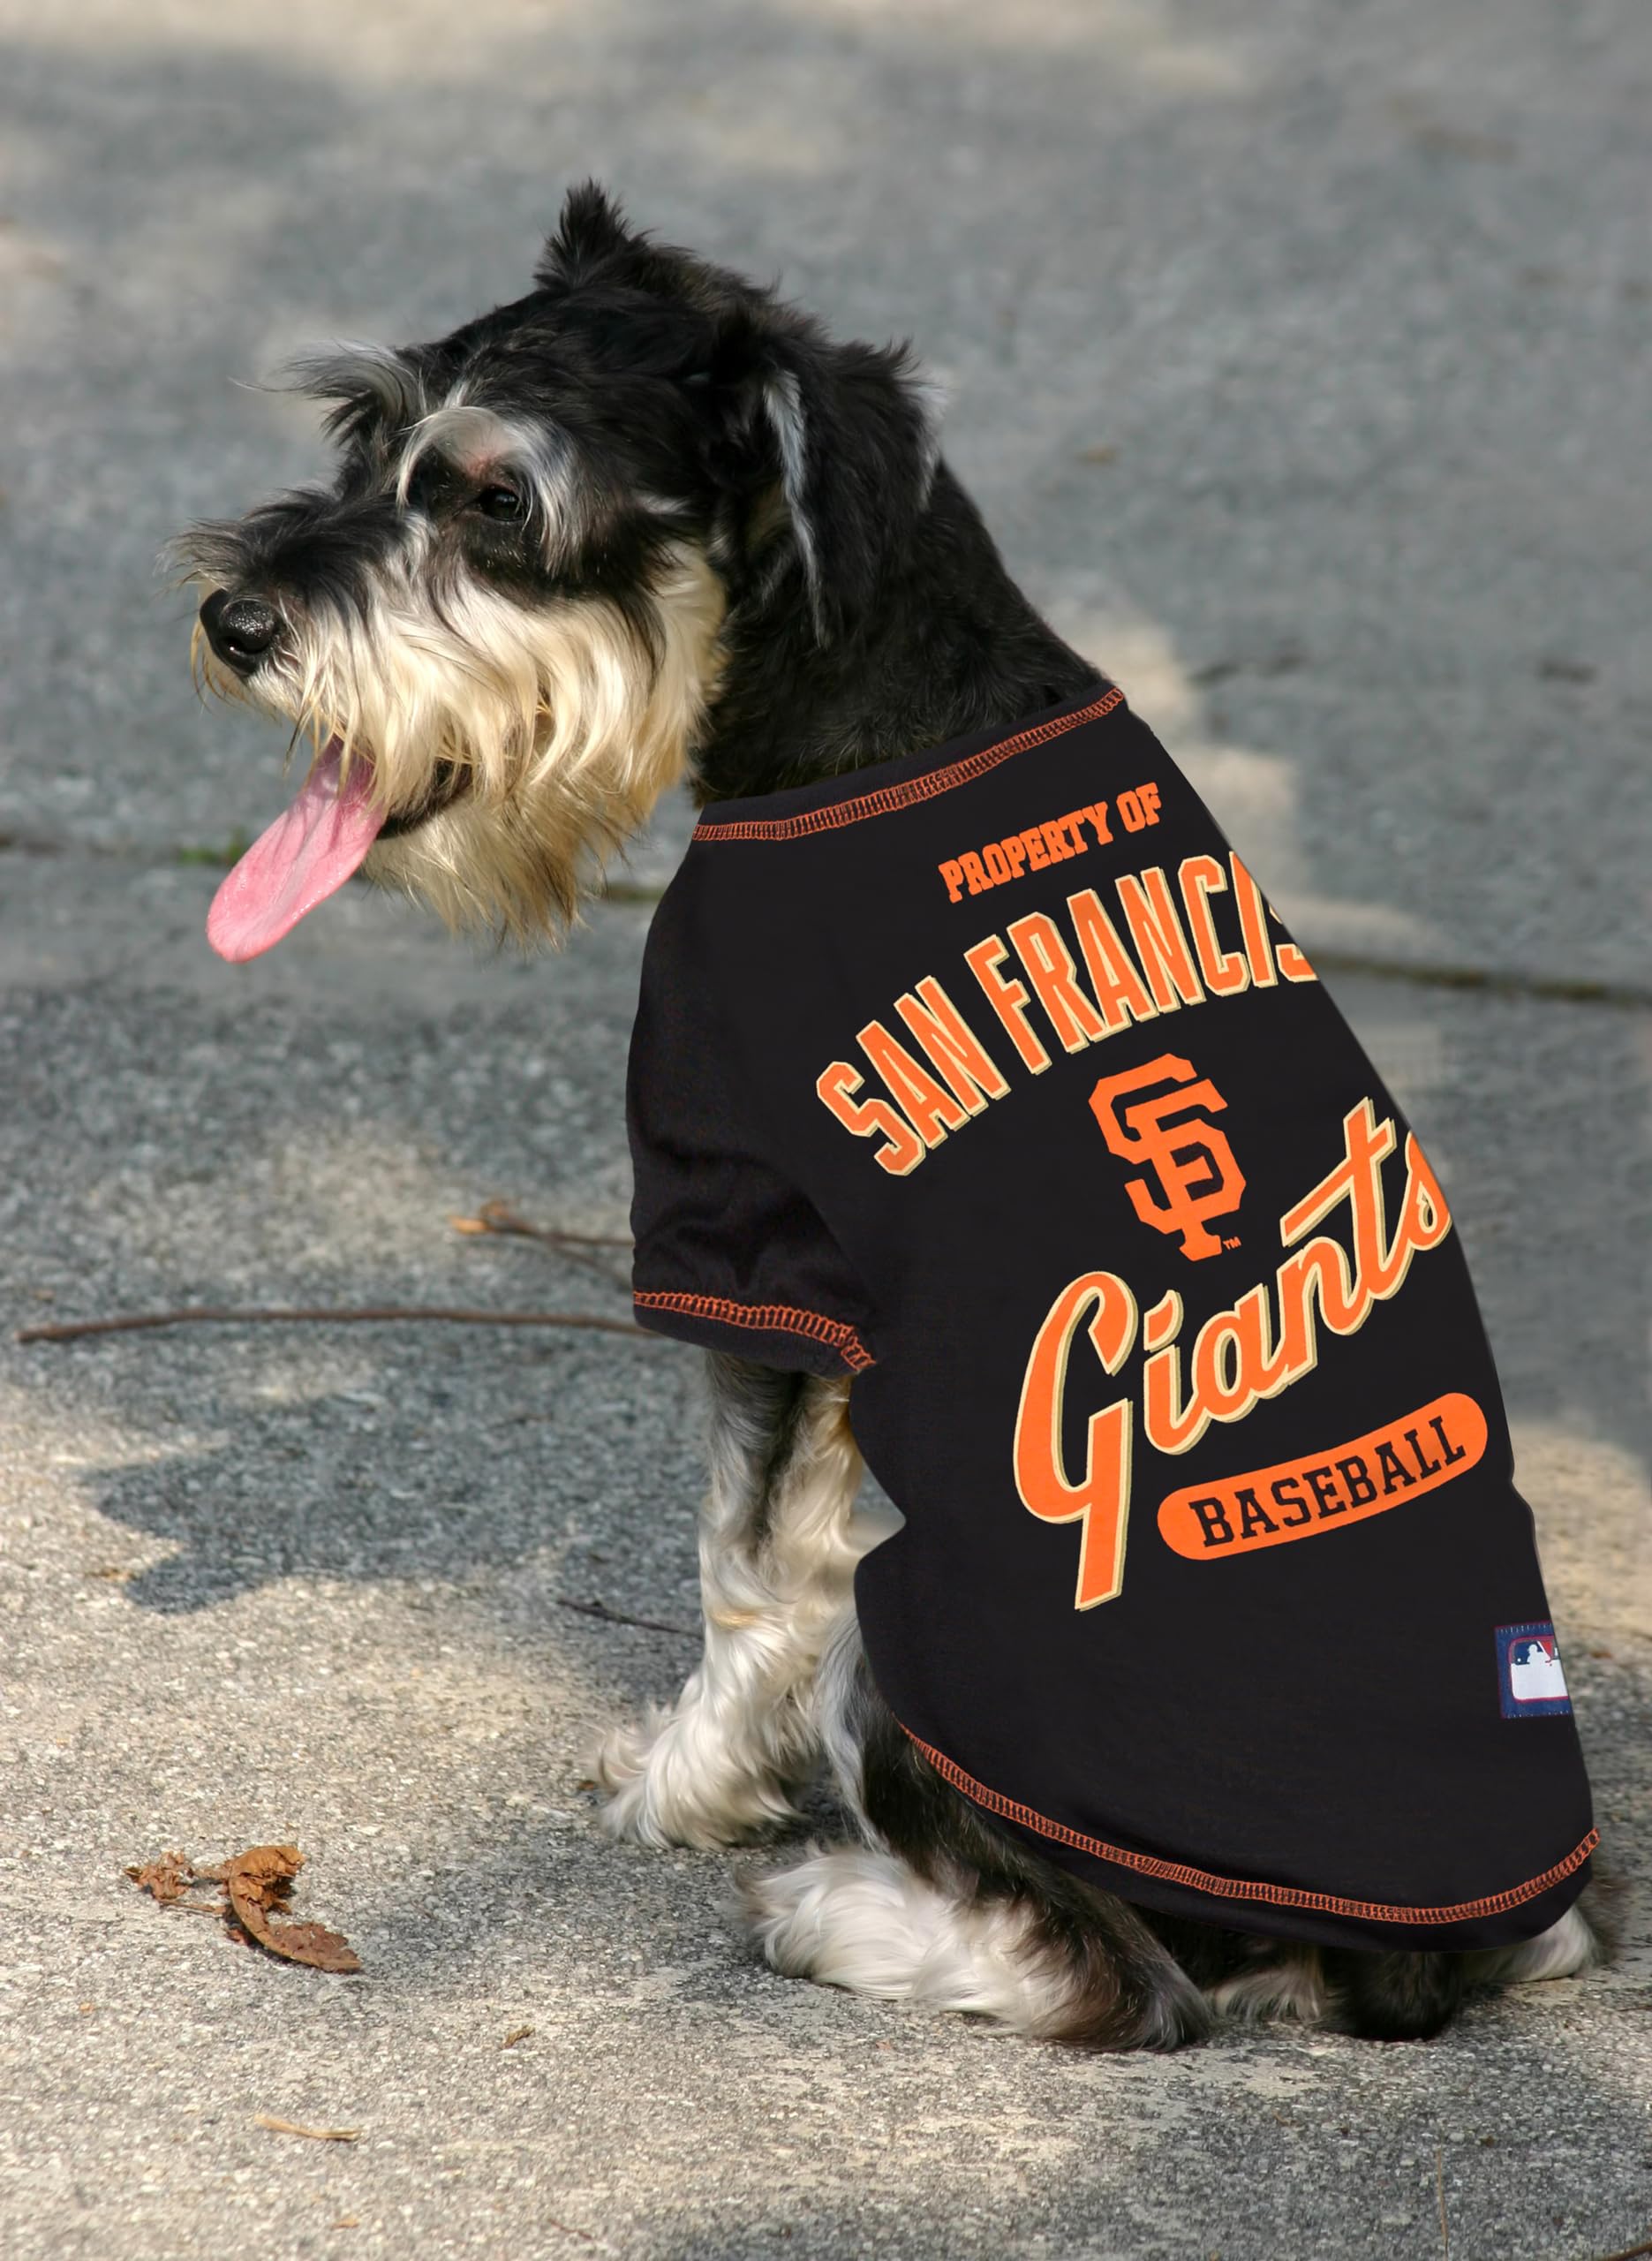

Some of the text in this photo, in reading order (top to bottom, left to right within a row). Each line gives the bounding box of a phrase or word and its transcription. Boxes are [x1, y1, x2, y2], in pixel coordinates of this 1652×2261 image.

[939, 783, 1161, 903] PROPERTY OF
[817, 976, 1011, 1176] SAN
[1089, 1053, 1246, 1261] SF
[1014, 1097, 1452, 1611] Giants
[1189, 1416, 1466, 1547] BASEBALL
